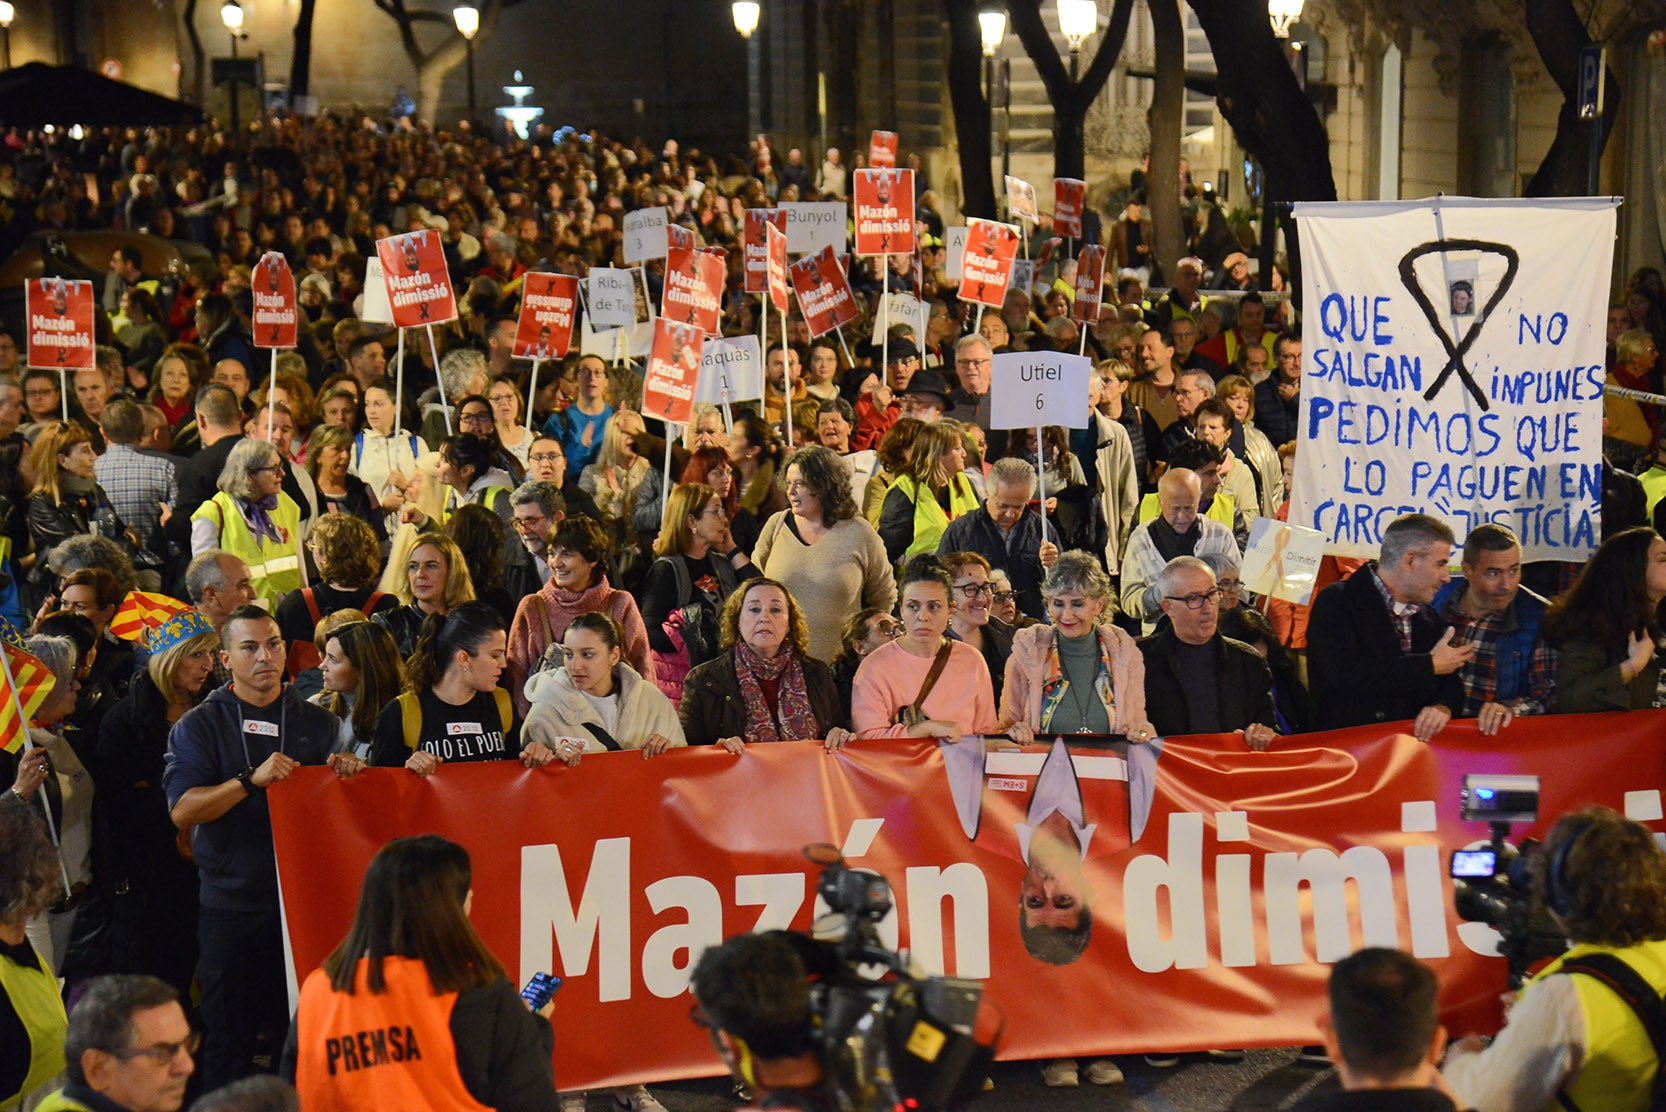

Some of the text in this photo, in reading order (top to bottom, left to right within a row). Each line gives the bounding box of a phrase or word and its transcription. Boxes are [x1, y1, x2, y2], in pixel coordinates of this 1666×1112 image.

[787, 208, 837, 226] Bunyol
[859, 204, 898, 220] Mazón
[859, 219, 911, 235] dimissió
[965, 251, 999, 271] Mazón
[388, 270, 431, 291] Mazón
[668, 270, 707, 293] Mazón
[255, 291, 285, 307] Mazón
[393, 282, 449, 307] dimissió
[667, 286, 718, 312] dimissió
[800, 281, 834, 303] Mazón
[526, 294, 573, 312] dimissió
[595, 299, 612, 310] de
[806, 287, 849, 318] dimissió
[32, 314, 76, 331] Mazón
[256, 307, 295, 324] dimissió
[534, 310, 571, 328] Mazón
[1320, 293, 1569, 346] QUE NO
[32, 331, 91, 347] dimissió
[651, 358, 685, 381] Mazón
[1020, 364, 1062, 382] Utiel
[1308, 349, 1422, 392] SALGAN
[648, 377, 693, 401] dimissió
[719, 375, 729, 388] 1
[1035, 393, 1044, 410] 6
[1516, 412, 1581, 463] QUE
[1344, 457, 1602, 502] LO PAGUEN EN
[456, 737, 474, 757] EL
[326, 1025, 422, 1076] PREMSA
